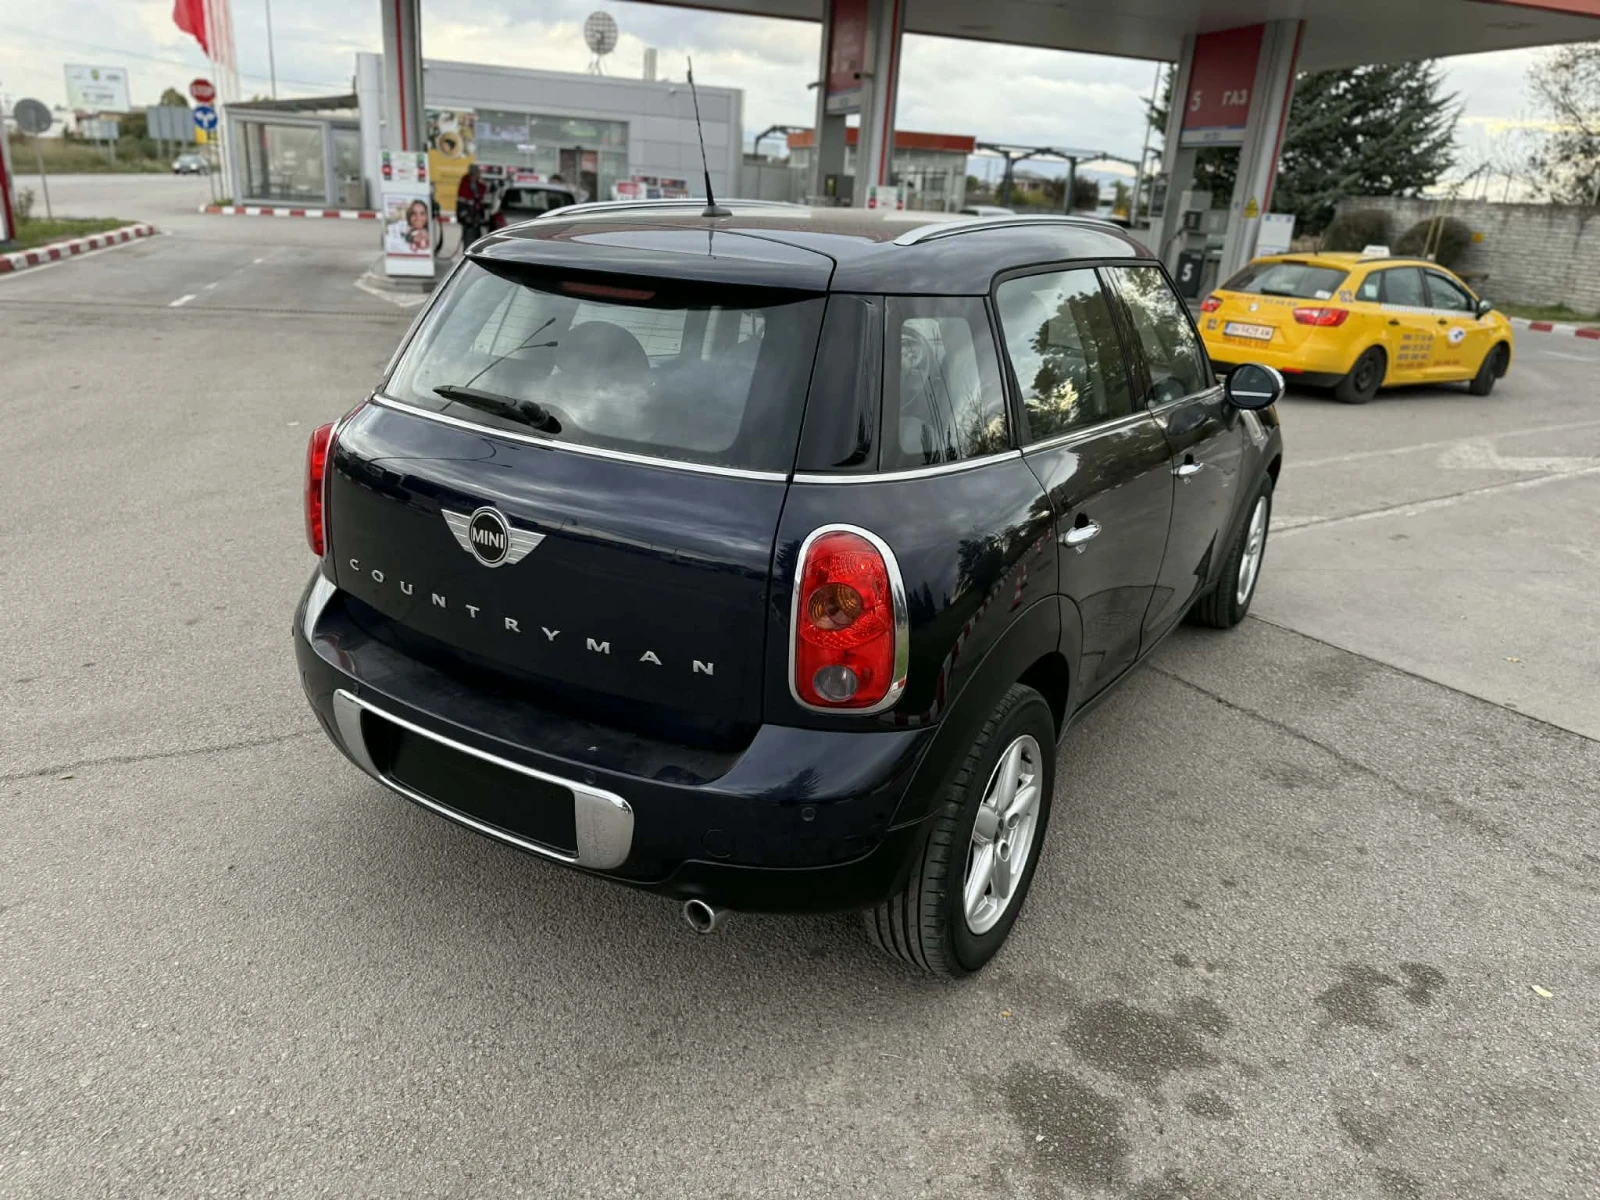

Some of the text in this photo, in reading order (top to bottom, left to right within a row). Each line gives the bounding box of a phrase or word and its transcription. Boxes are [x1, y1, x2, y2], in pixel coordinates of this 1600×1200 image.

[1190, 88, 1248, 112] 5 ГАЗ
[1181, 263, 1194, 282] 5
[472, 526, 504, 549] MINI
[350, 557, 714, 675] COUNTRYMAN
